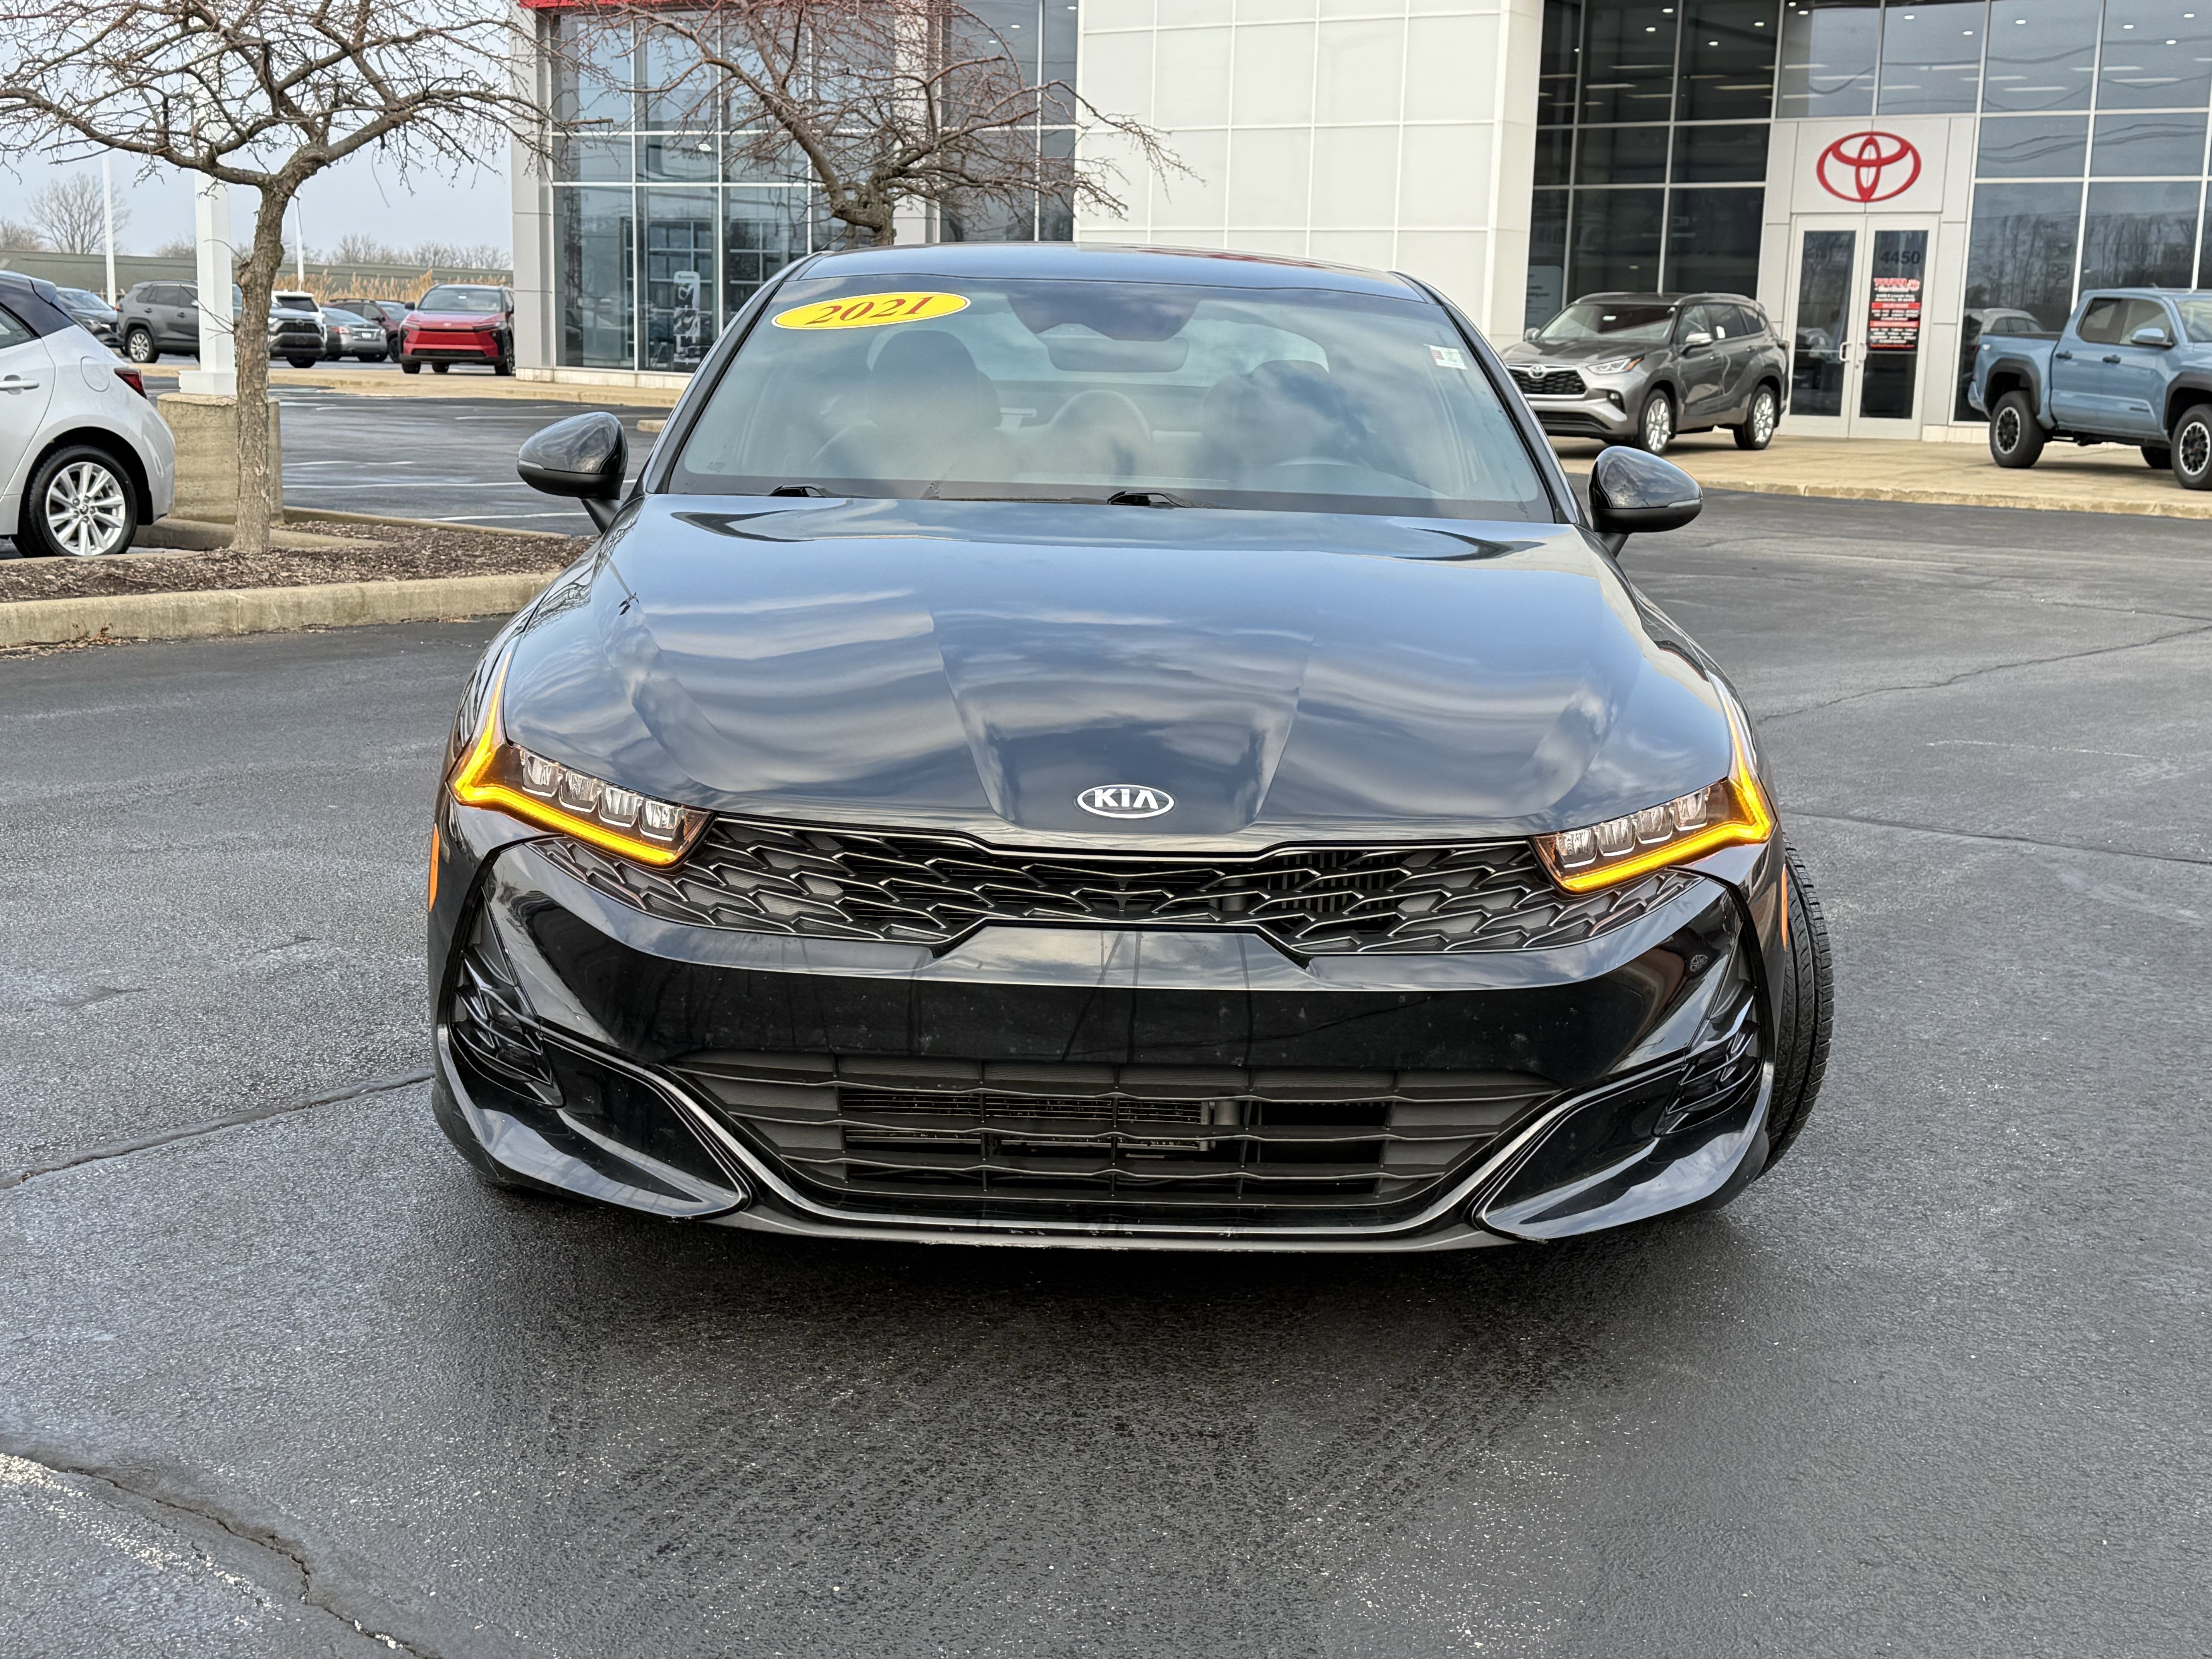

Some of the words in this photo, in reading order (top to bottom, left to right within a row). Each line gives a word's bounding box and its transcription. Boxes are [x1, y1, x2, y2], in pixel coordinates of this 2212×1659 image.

[1880, 251, 1920, 264] 4450
[804, 296, 935, 325] 2021
[1093, 788, 1159, 809] KIA
